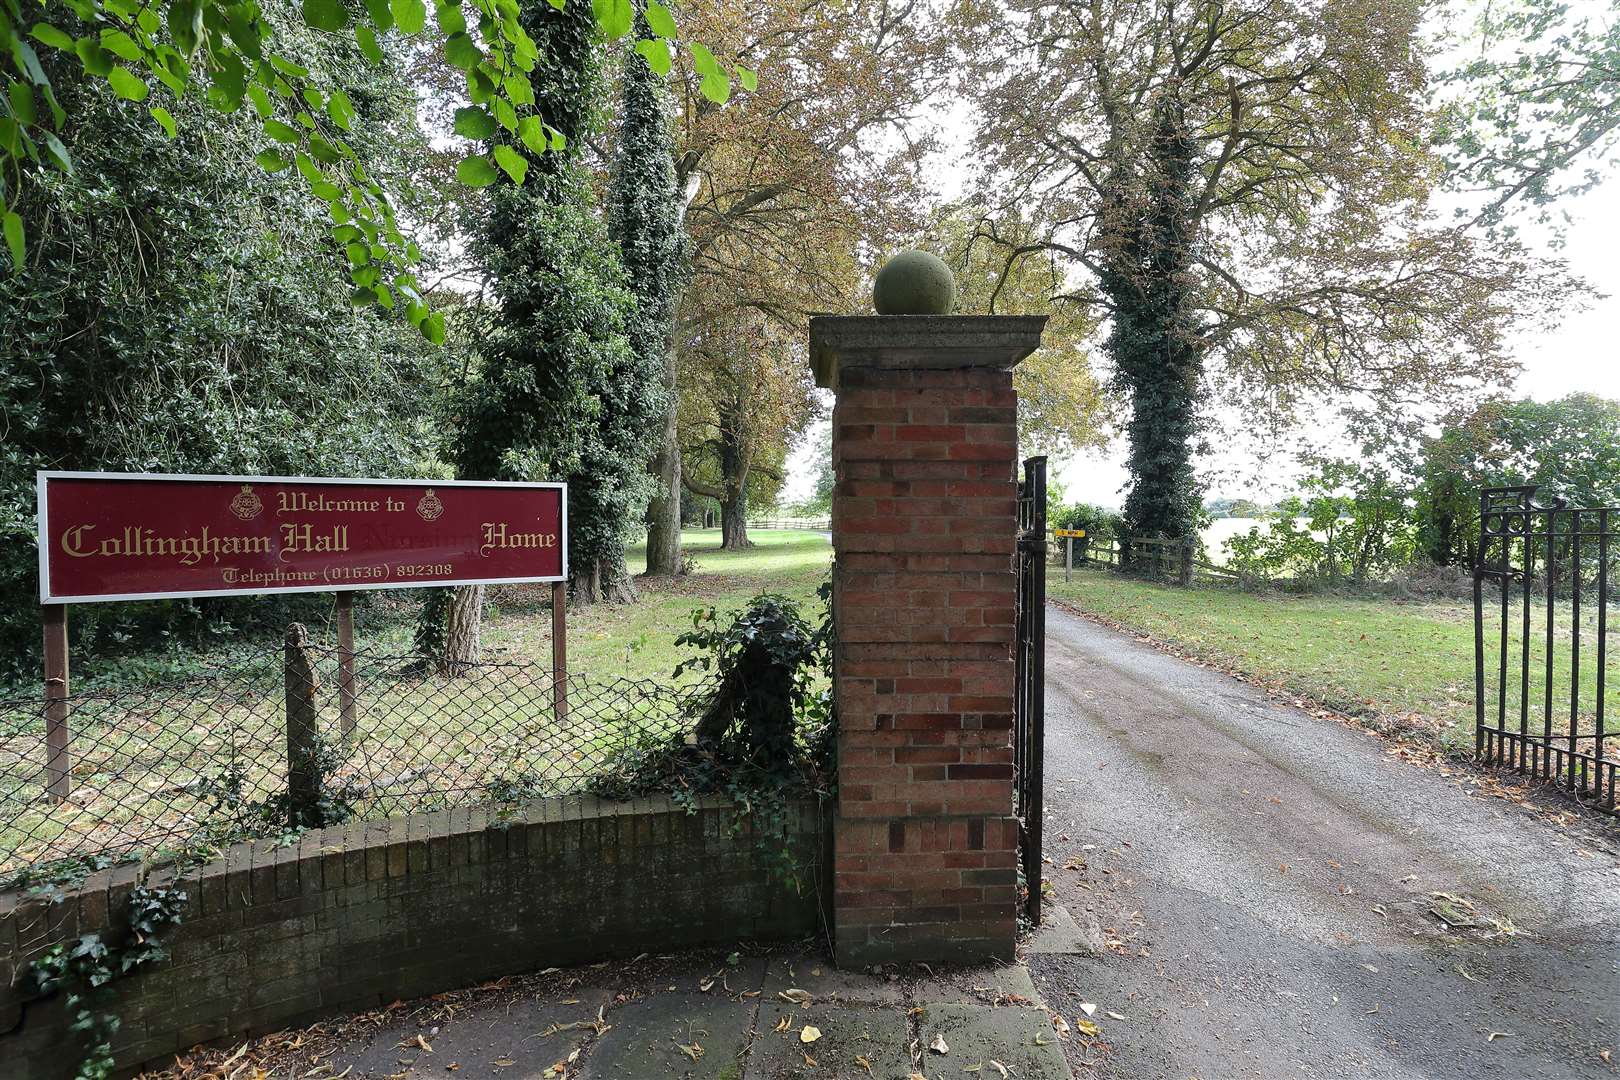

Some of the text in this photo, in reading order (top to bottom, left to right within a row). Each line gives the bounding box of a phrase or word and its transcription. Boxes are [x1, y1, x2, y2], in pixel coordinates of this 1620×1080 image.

[276, 491, 406, 515] Welcome to
[61, 523, 272, 565] Collingham
[278, 522, 351, 563] Hall
[480, 522, 556, 557] Home
[222, 562, 453, 587] Telephone (01636) 892308
